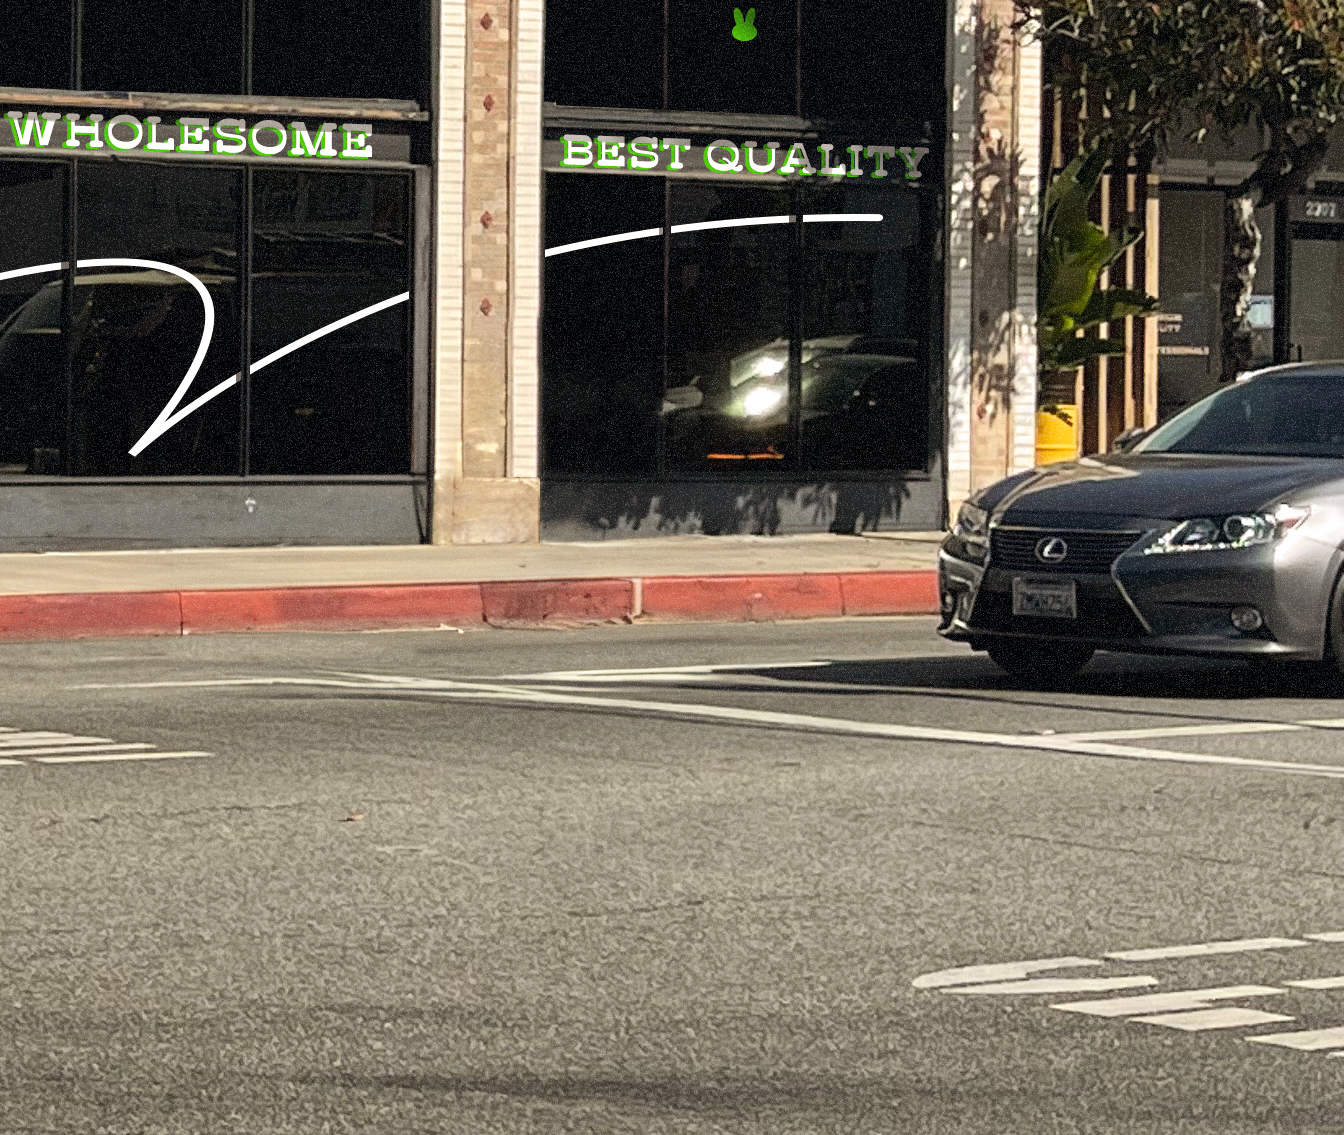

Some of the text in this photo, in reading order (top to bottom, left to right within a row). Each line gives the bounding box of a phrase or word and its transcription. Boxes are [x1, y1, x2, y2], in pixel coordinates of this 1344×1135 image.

[6, 111, 374, 159] WHOLESOME
[559, 134, 930, 179] BEST QUALITY
